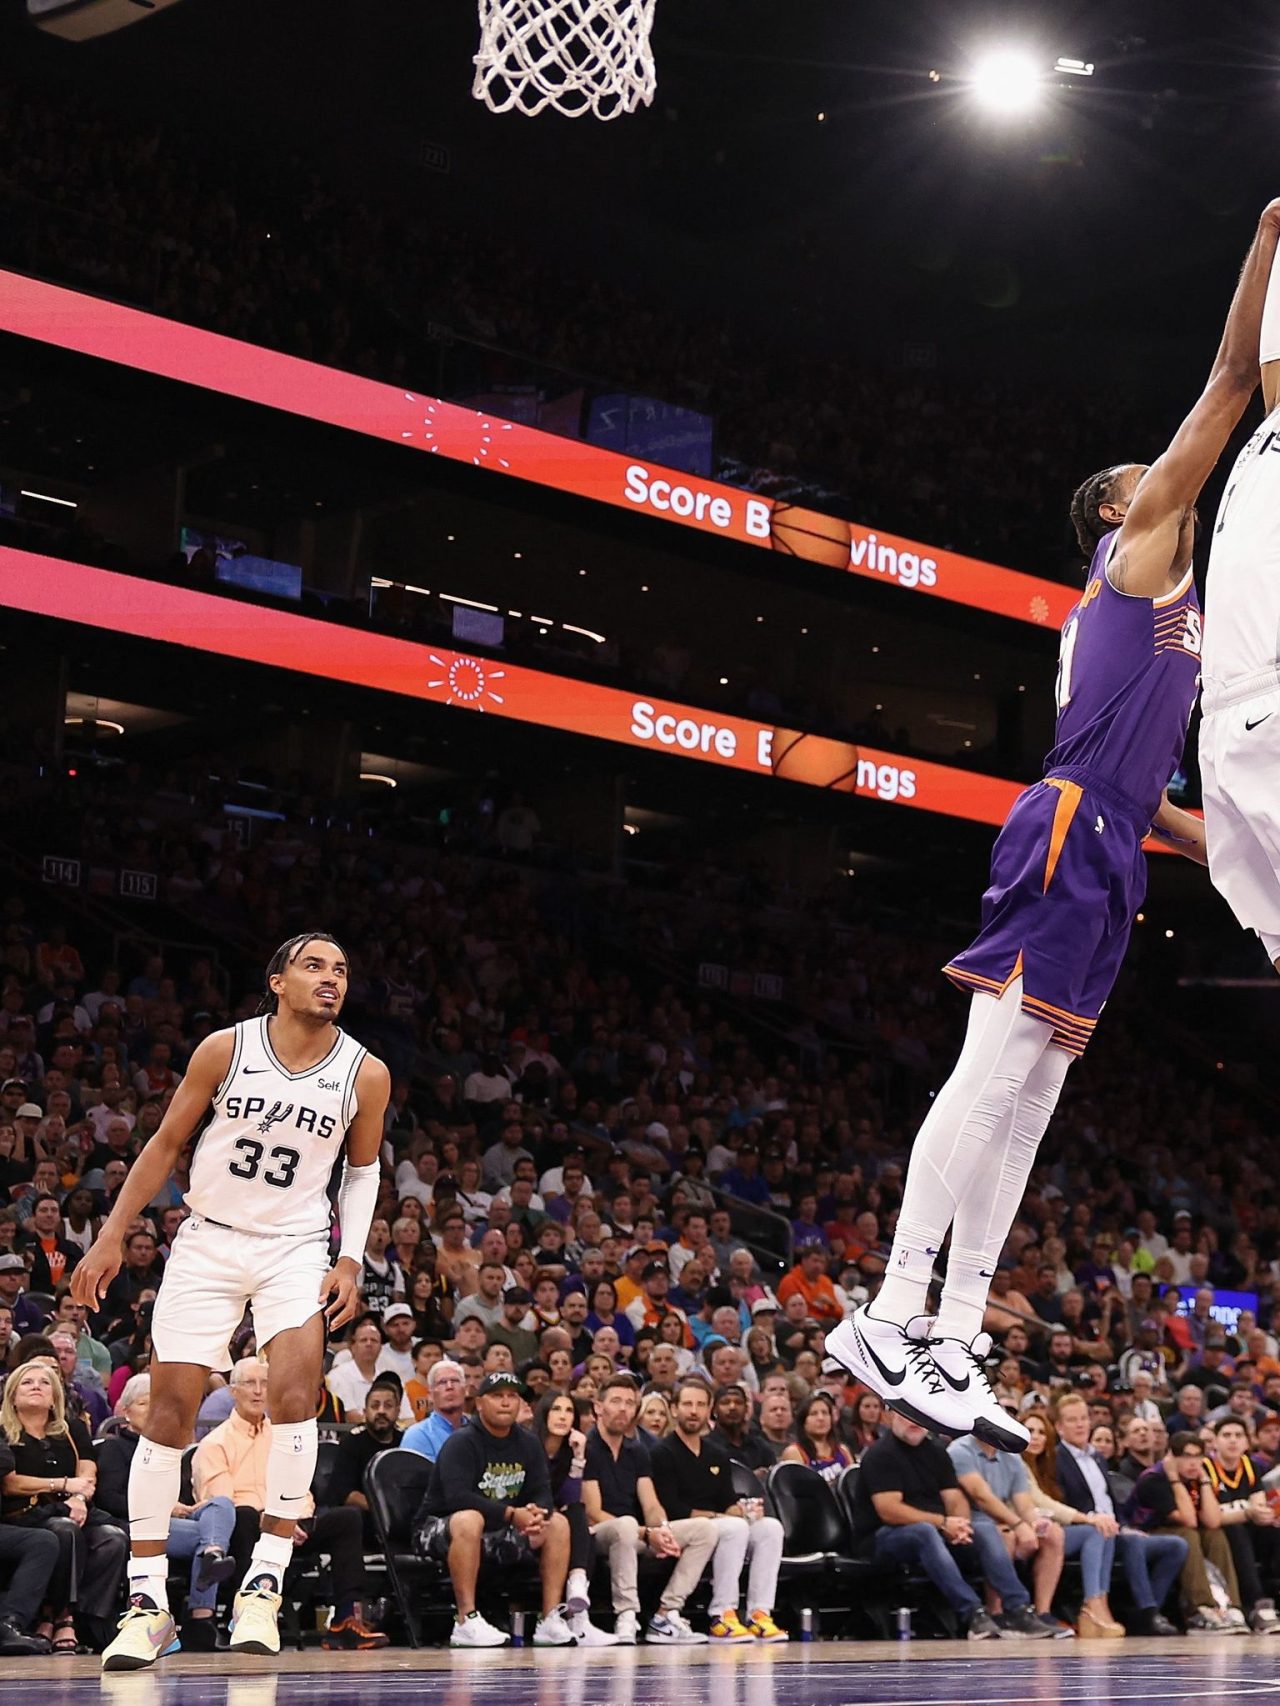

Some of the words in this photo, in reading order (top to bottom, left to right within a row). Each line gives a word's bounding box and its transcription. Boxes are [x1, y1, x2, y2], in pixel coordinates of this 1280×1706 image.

[624, 465, 733, 528] Score
[630, 701, 737, 758] Score
[50, 861, 73, 881] 114
[128, 875, 150, 895] 115
[317, 1078, 342, 1093] Self.
[229, 1137, 301, 1189] 33
